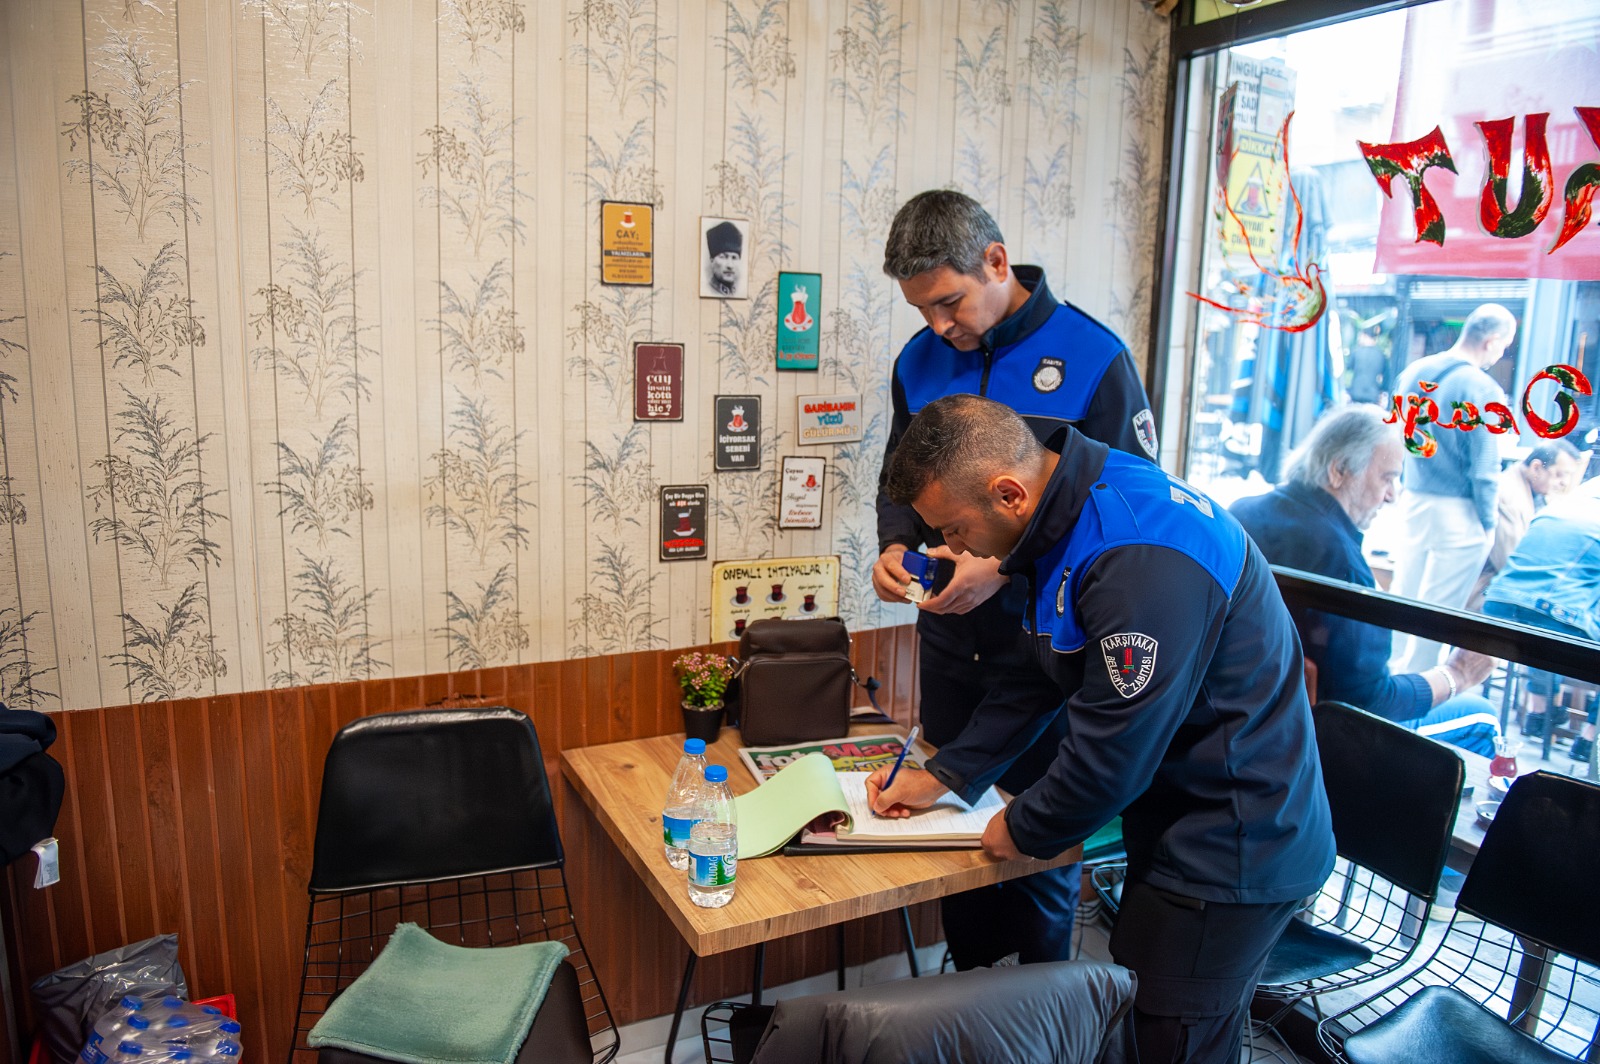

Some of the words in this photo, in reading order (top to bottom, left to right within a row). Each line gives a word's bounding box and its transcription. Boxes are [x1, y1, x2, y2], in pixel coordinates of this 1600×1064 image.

[817, 411, 843, 426] YÜZÜ
[730, 454, 745, 462] VAR
[1103, 635, 1155, 653] KARŞIYAKA
[1129, 656, 1153, 692] ZABITASI
[707, 856, 719, 886] ULUDAĞ
